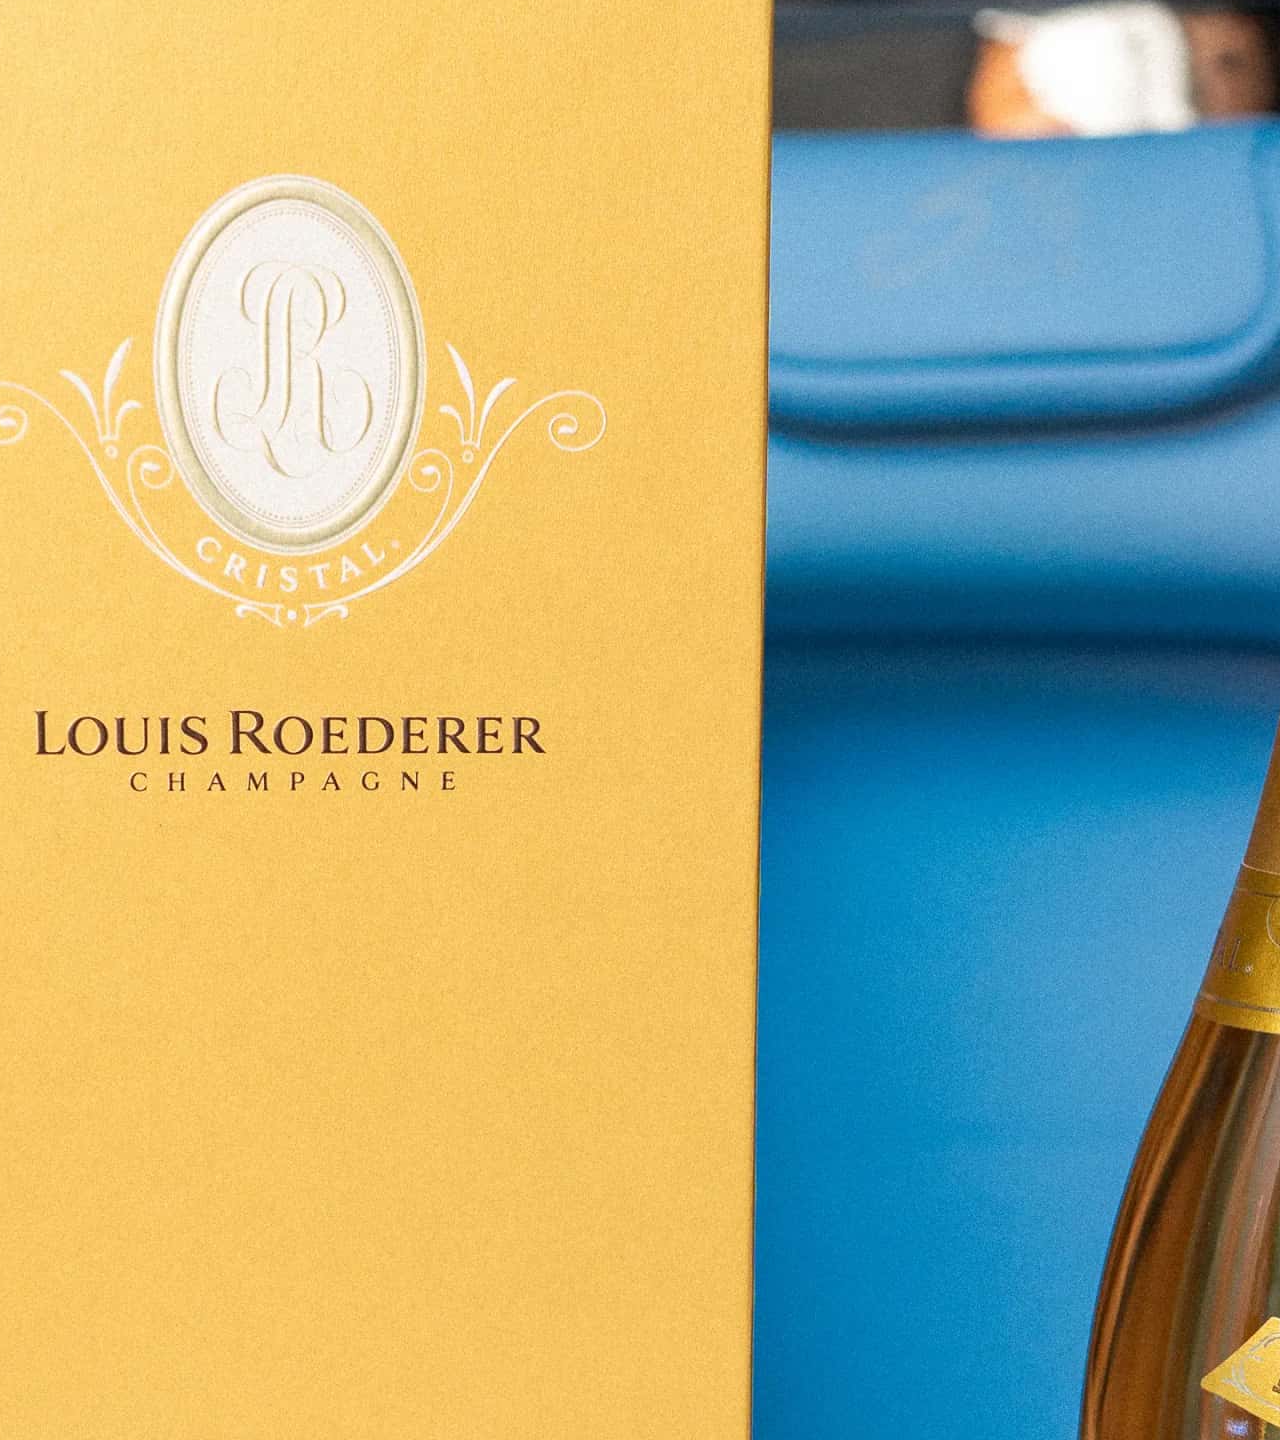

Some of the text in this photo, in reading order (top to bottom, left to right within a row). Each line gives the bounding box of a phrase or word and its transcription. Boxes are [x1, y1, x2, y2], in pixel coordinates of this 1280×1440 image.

[34, 709, 548, 756] LOUIS ROEDERER
[129, 770, 457, 793] CHAMPAGNE
